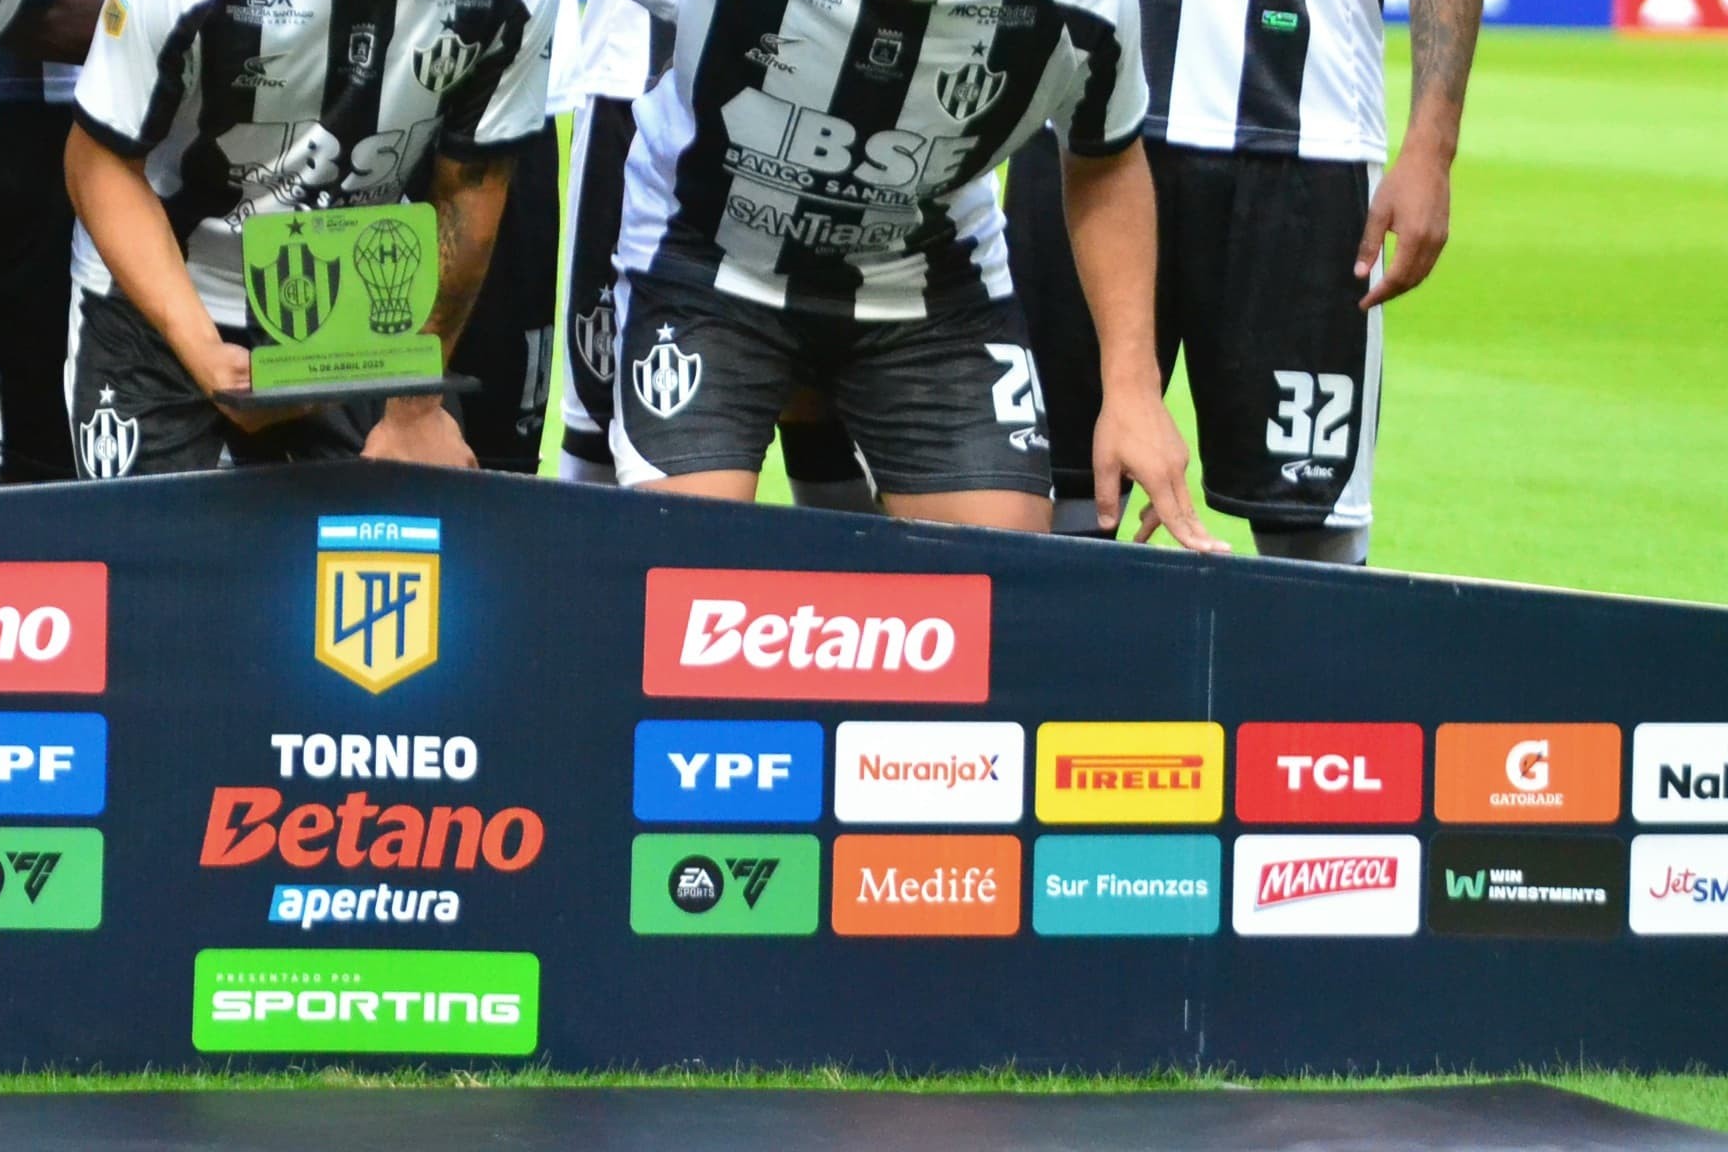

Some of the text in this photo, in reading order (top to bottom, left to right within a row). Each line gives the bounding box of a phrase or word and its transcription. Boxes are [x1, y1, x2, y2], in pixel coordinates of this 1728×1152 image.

[784, 106, 980, 195] BSE
[725, 147, 919, 206] BANCO SANTI
[1266, 370, 1354, 459] 32
[358, 522, 399, 541] AFA
[680, 599, 955, 672] Betano
[272, 734, 478, 781] TORNEO
[668, 752, 793, 790] YPF
[1055, 754, 1203, 790] PIRELLI
[1277, 754, 1382, 792] TCL
[1489, 792, 1564, 807] GATORADE
[1659, 763, 1728, 800] Nal
[199, 786, 545, 871] Betano
[676, 887, 715, 898] SPORTS
[677, 867, 714, 888] EA
[857, 866, 998, 905] Medifé
[1045, 872, 1209, 899] Sur Finanzas
[1262, 856, 1393, 899] MANTECOL
[1490, 868, 1523, 884] WIN
[1649, 865, 1728, 902] JetSM
[276, 883, 461, 929] apertura
[1488, 885, 1608, 905] INVESTMENTS
[216, 972, 322, 984] PRESENTADO
[212, 990, 522, 1024] SPORTING
